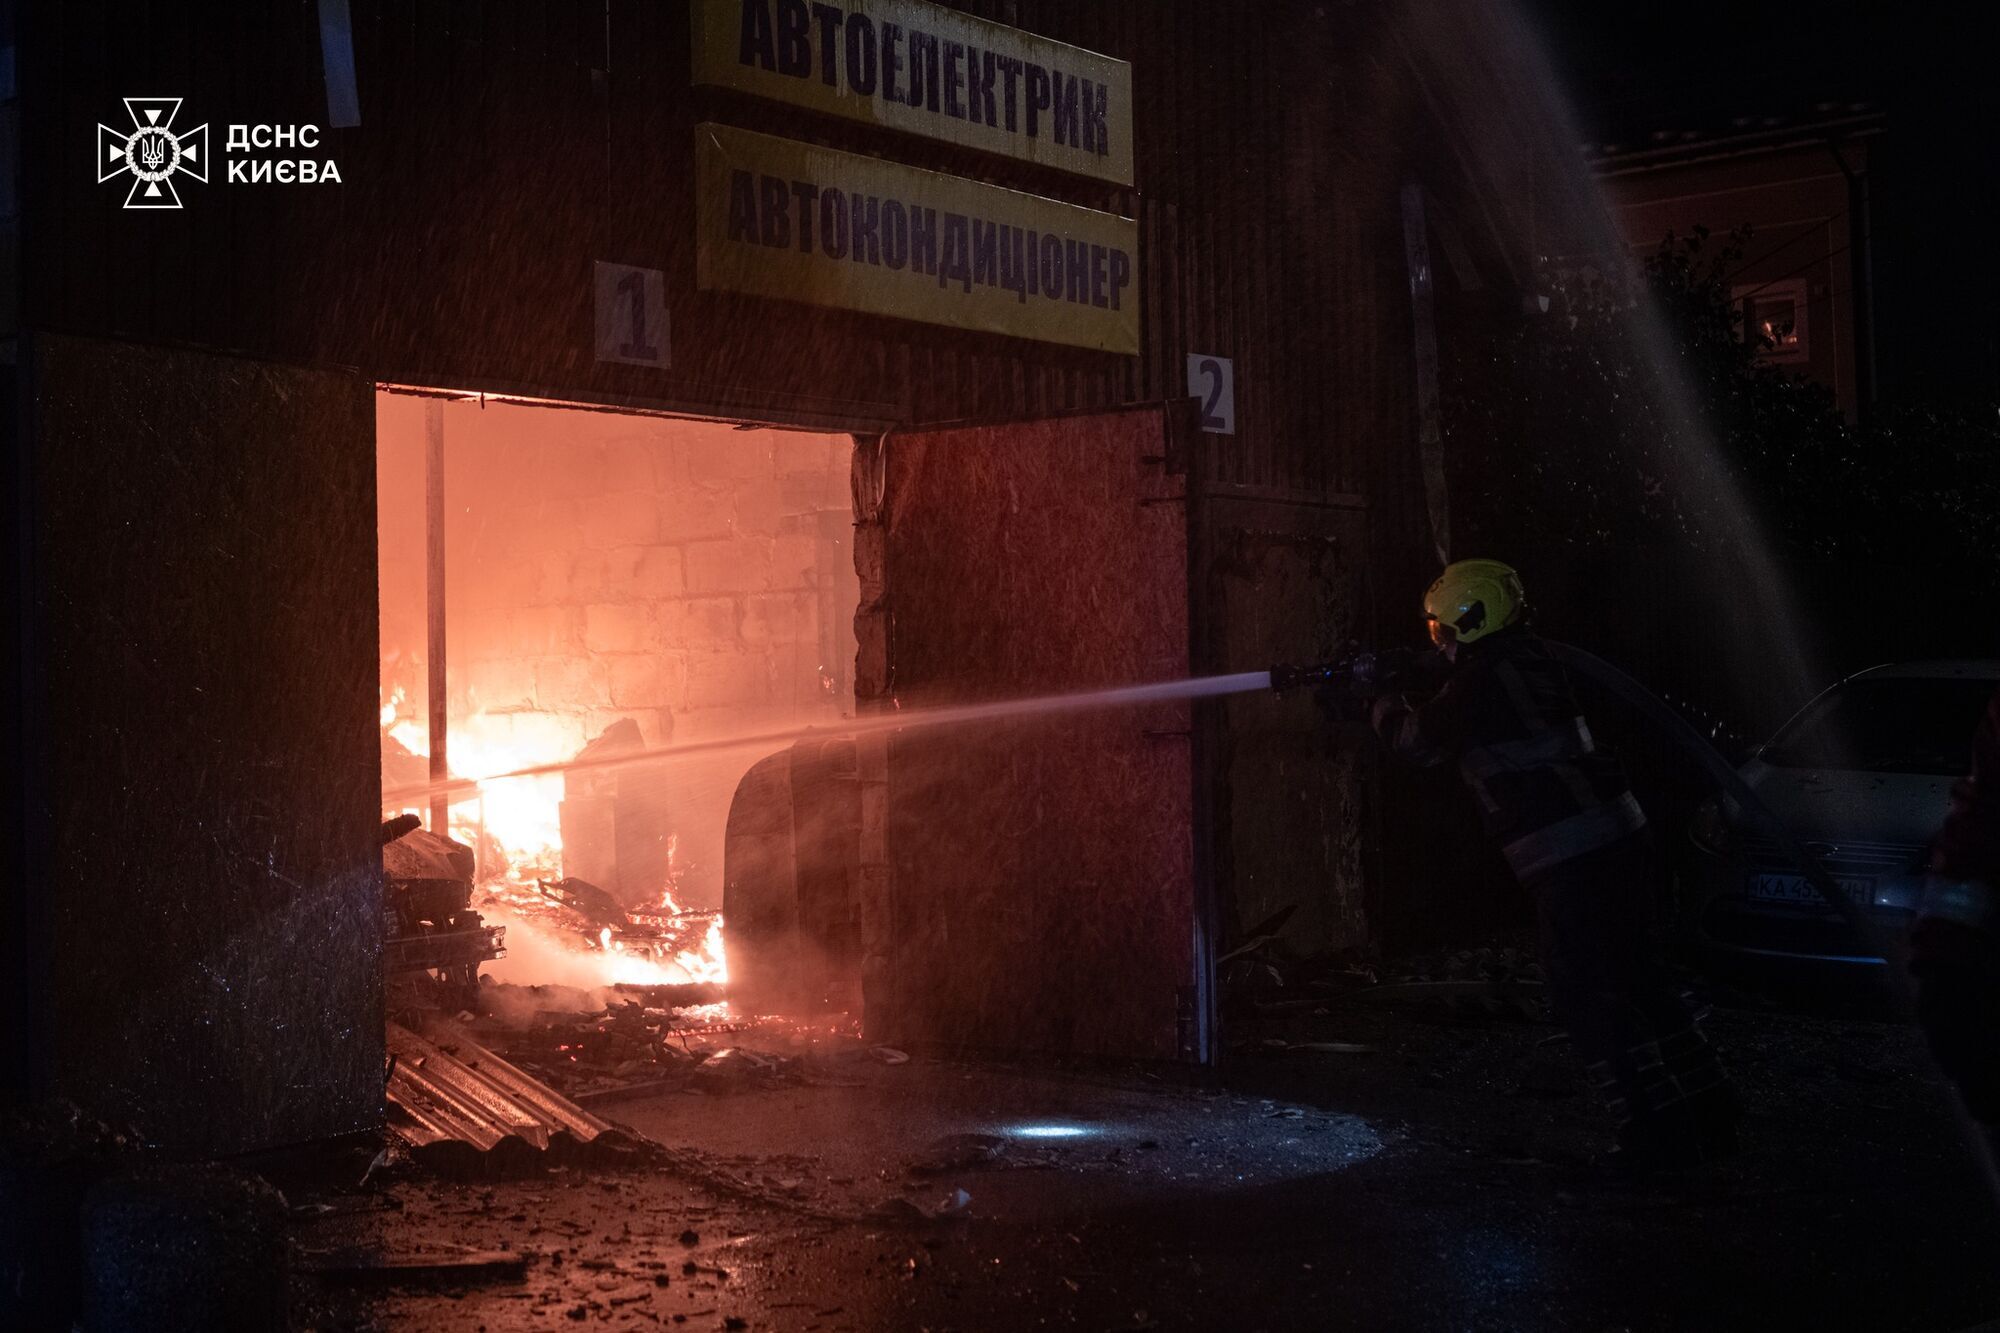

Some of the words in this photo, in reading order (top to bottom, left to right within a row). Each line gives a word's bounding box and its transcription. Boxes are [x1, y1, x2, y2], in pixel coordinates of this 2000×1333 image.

[740, 0, 1108, 156] АВТОЕЛЕКТРИК
[728, 168, 1130, 311] АВТОКОНДИЦІОНЕР
[617, 271, 658, 361] 1
[1200, 359, 1225, 429] 2
